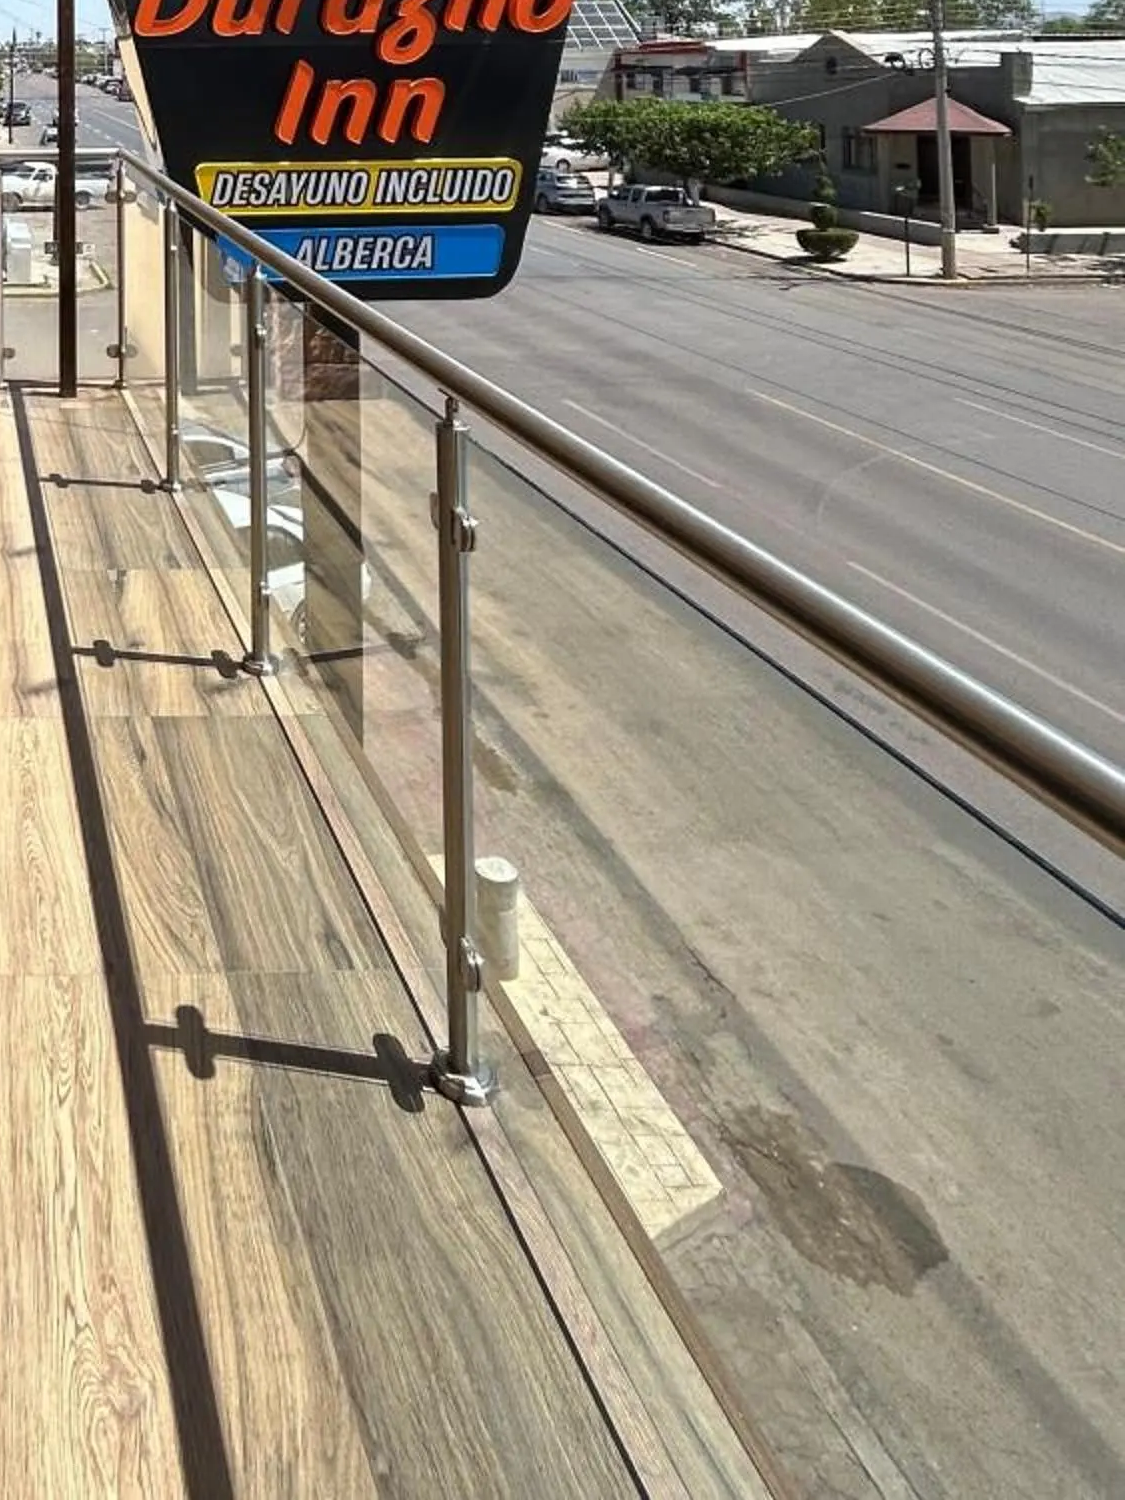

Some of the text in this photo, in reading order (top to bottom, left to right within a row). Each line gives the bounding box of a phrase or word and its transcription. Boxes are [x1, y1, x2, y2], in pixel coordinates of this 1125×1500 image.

[275, 58, 446, 146] Inn
[211, 167, 514, 207] DESAYUNO INCLUIDO
[294, 235, 434, 273] ALBERCA
